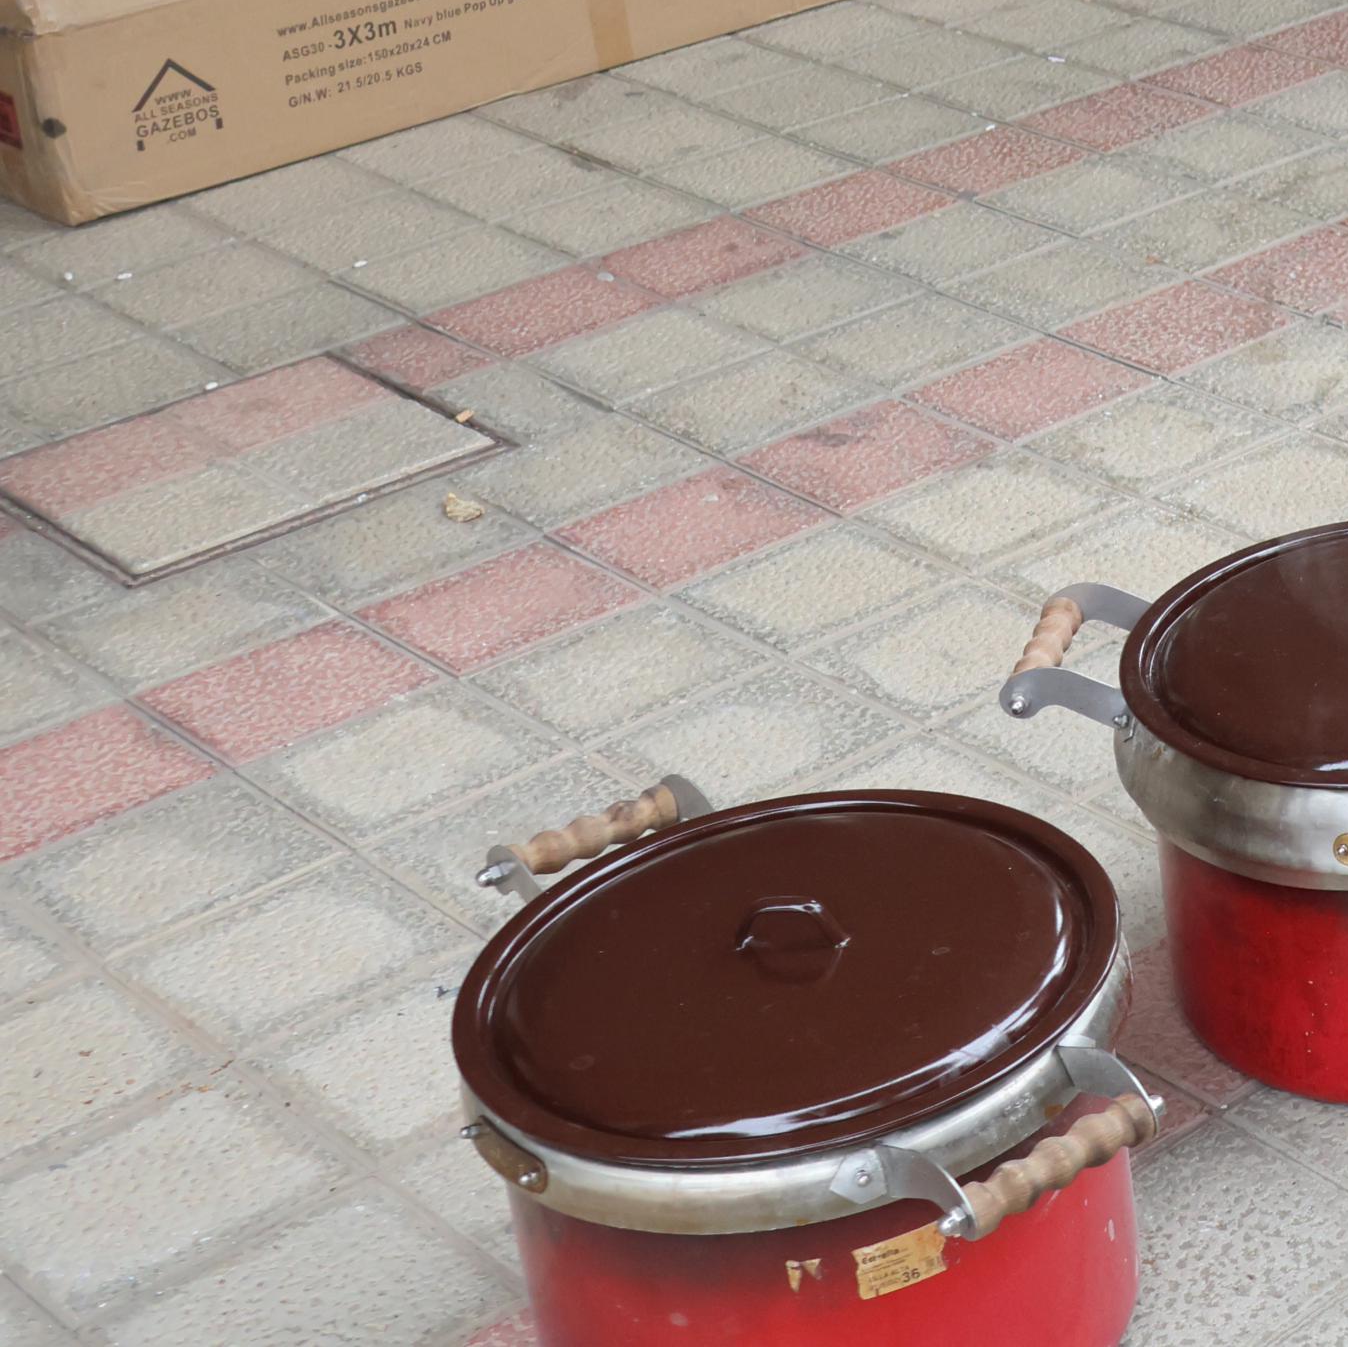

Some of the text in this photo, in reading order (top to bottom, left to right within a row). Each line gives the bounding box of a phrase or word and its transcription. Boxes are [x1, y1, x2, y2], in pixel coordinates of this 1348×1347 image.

[282, 41, 326, 62] ASG30
[404, 15, 433, 29] Navy
[436, 5, 462, 21] blue
[464, 0, 487, 14] Pop
[285, 66, 336, 86] Packing
[432, 30, 452, 45] CM
[396, 61, 423, 78] KGS
[134, 92, 219, 125] ALL SEASONS
[136, 104, 220, 138] GAZEBOS
[902, 1267, 921, 1283] 36
